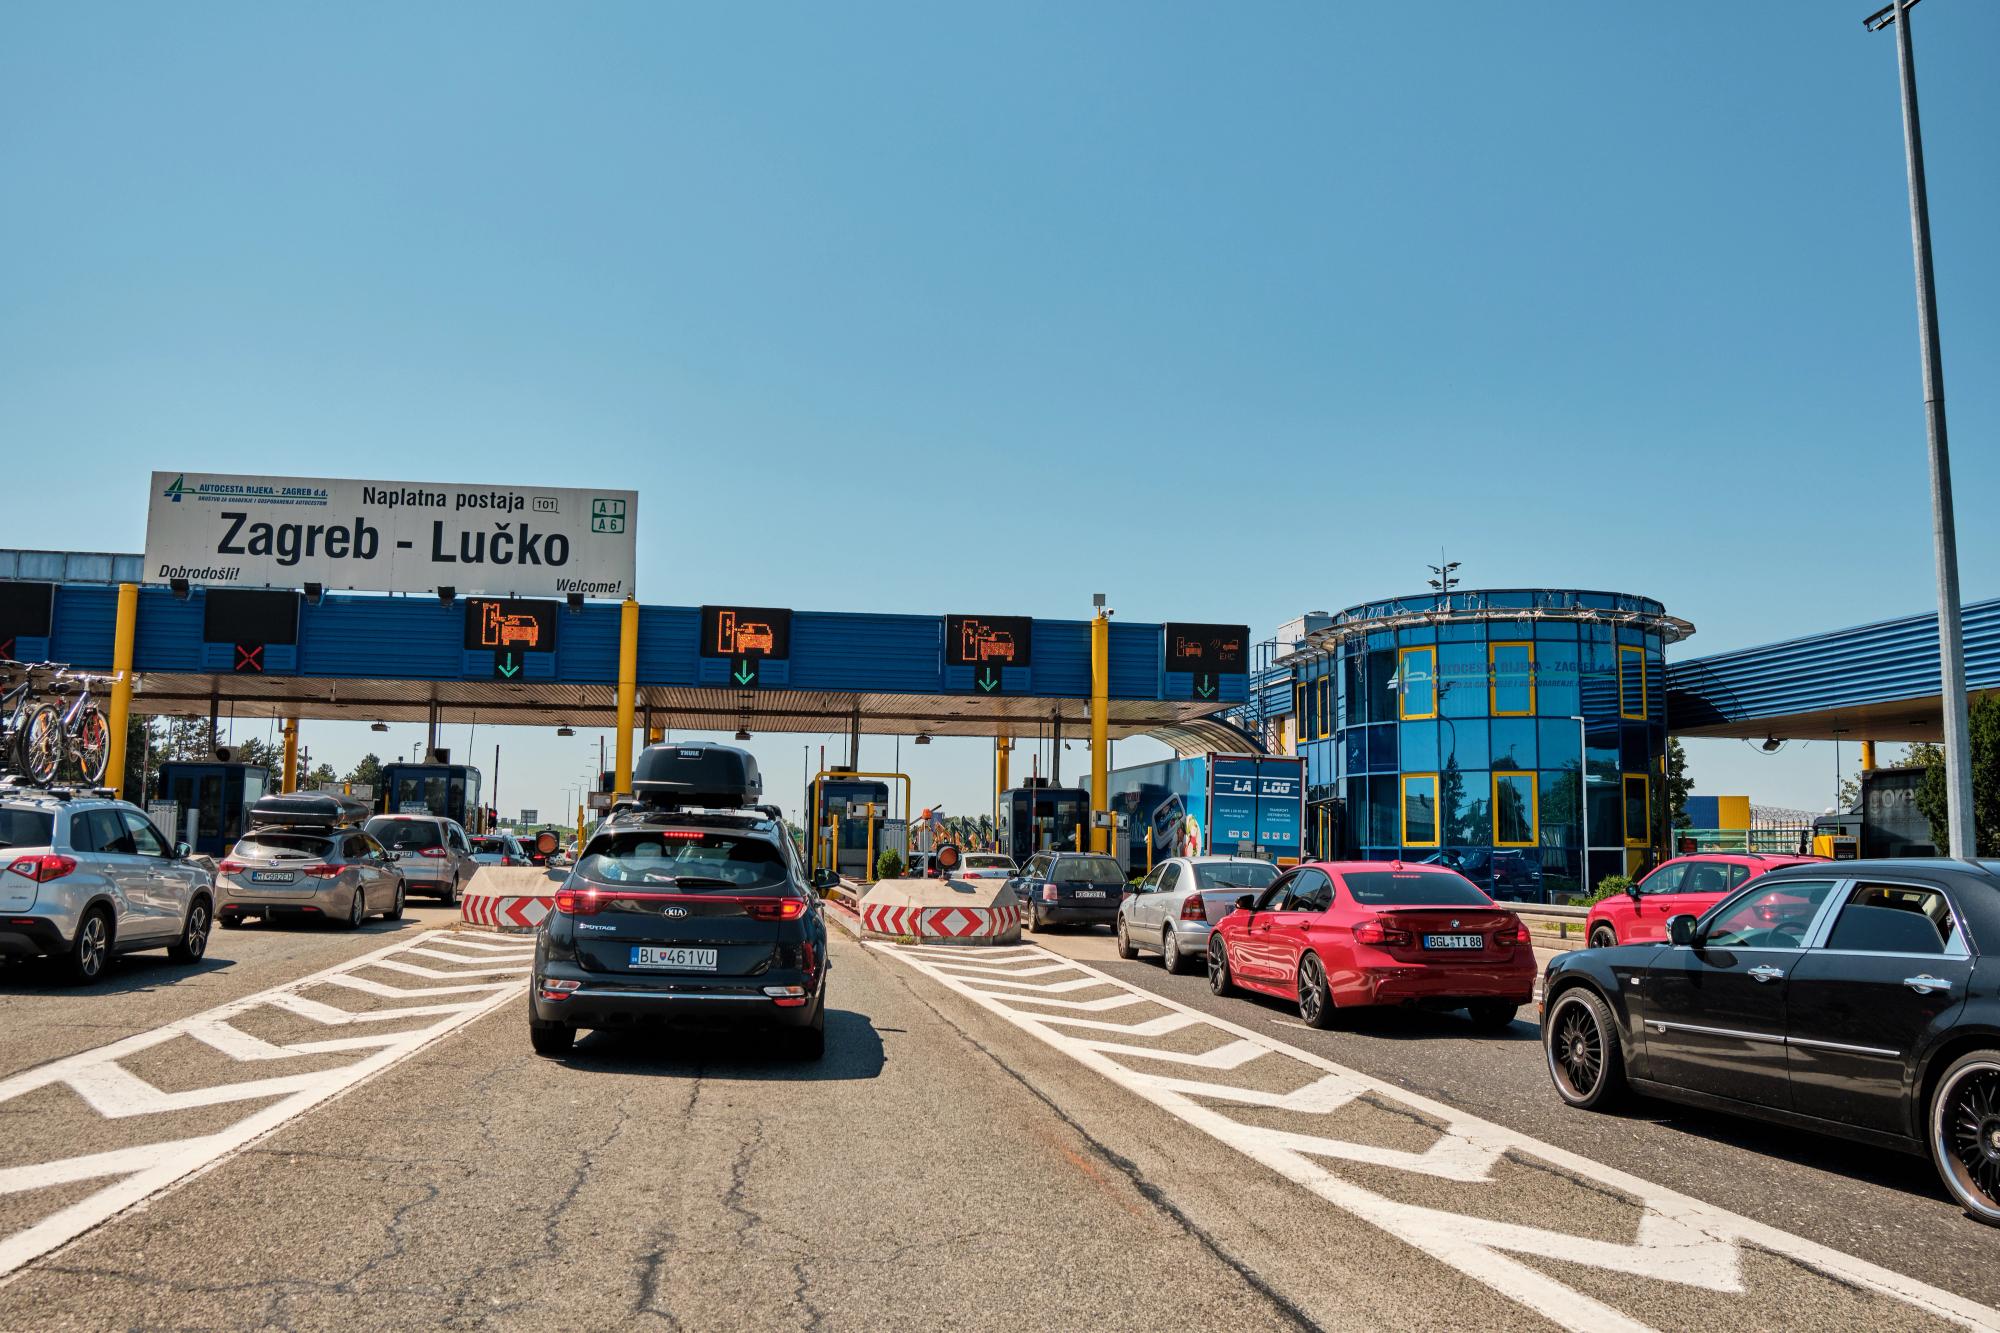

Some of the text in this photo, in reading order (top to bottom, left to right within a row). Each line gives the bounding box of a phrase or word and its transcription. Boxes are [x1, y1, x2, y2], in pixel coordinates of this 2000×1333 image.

[200, 484, 244, 493] AUTOCESTA
[246, 486, 274, 494] RIJEKA
[282, 487, 312, 496] ZAGREB
[314, 488, 328, 496] d.d.
[362, 487, 554, 514] Naplatna postaja 101
[217, 512, 379, 566] Zagreb
[432, 520, 570, 566] Lučko
[158, 564, 240, 580] Dobrodošli!
[556, 578, 622, 594] Welcome!
[1234, 780, 1290, 794] LA LOG
[1430, 936, 1450, 947] BGL
